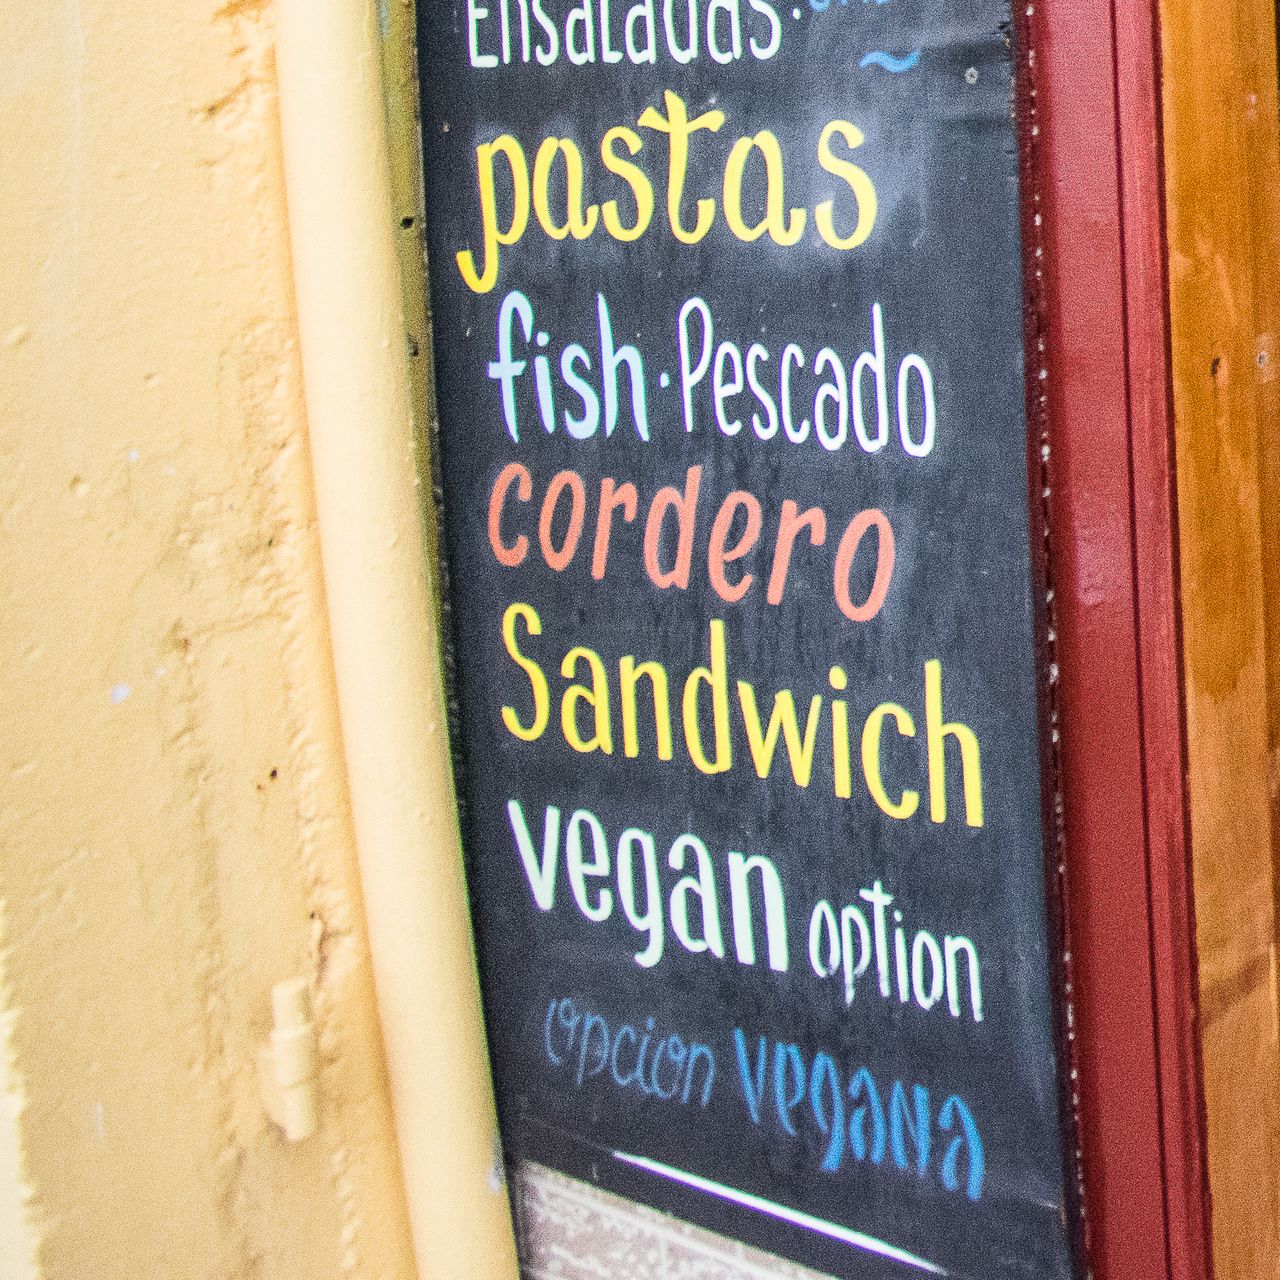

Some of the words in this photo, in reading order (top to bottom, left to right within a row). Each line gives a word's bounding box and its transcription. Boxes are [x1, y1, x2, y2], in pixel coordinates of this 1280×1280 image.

[456, 90, 879, 293] pastas
[487, 290, 650, 442] fish
[677, 297, 937, 459] Pescado
[489, 463, 896, 622] cordero
[502, 603, 983, 827] Sandwich
[507, 801, 788, 972] vegan
[807, 881, 983, 1022] option
